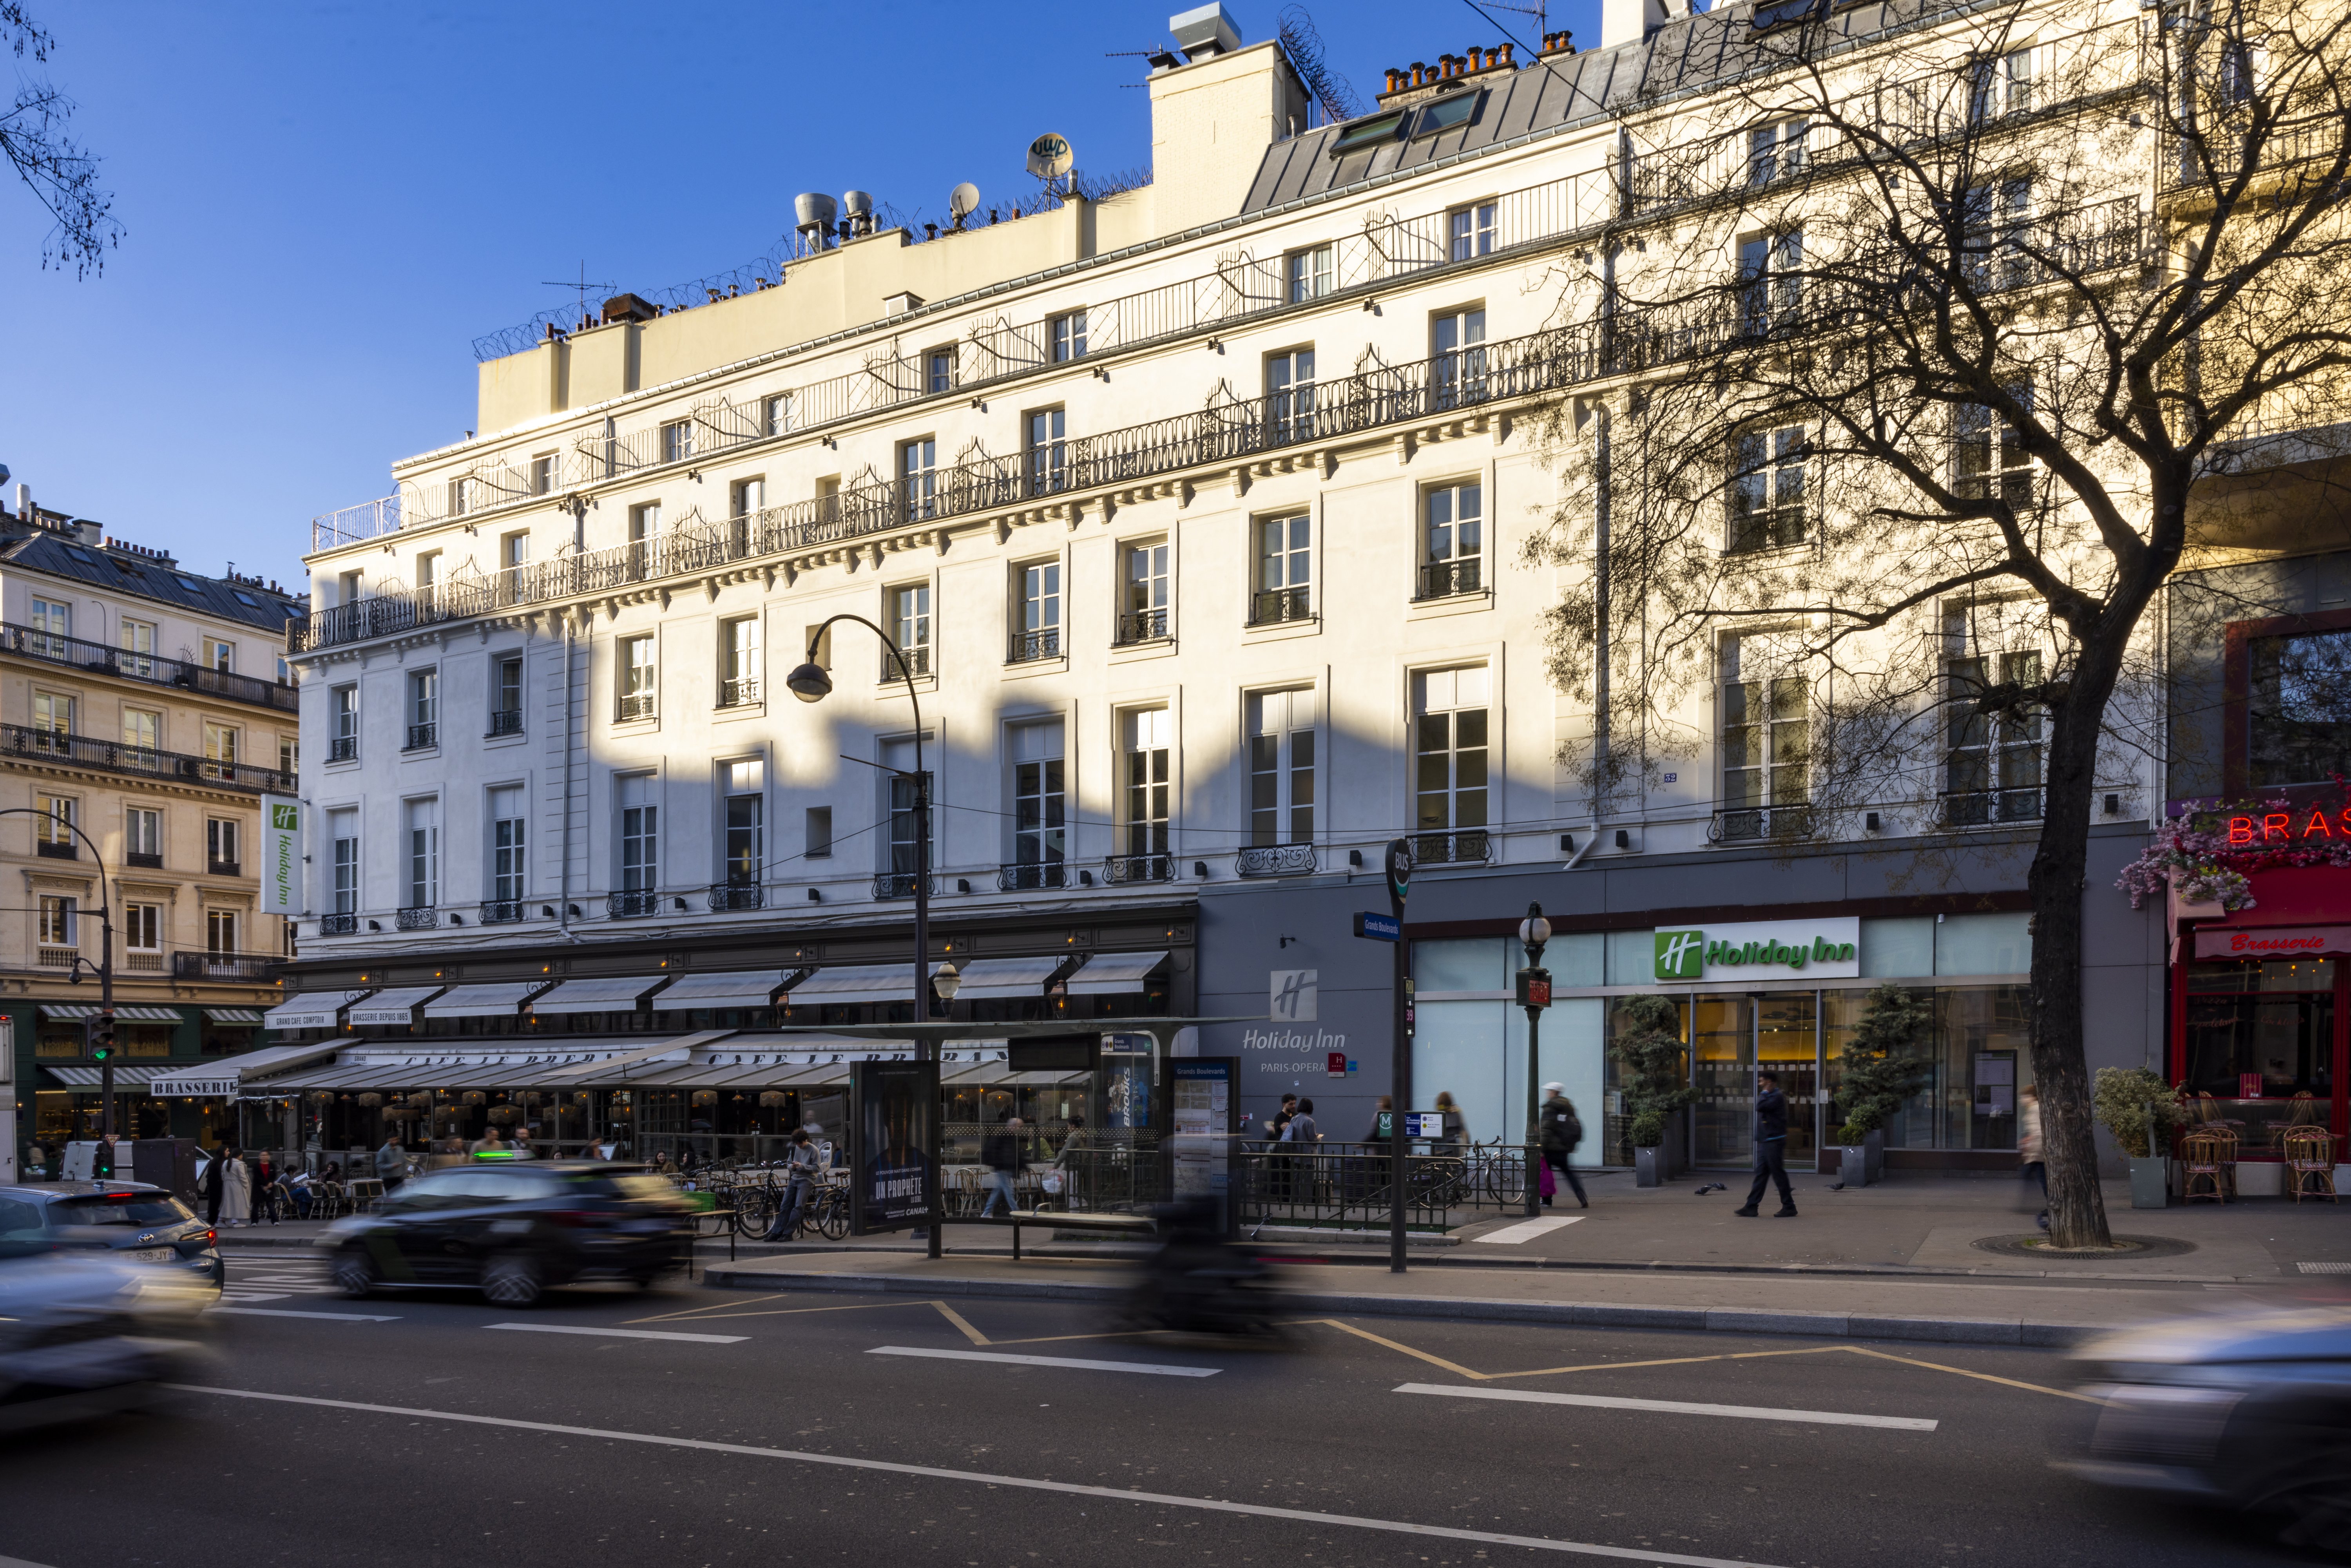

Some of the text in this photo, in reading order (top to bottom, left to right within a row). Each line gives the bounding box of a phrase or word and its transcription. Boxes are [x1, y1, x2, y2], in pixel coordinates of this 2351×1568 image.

[1395, 852, 1408, 871] BUS
[276, 834, 291, 905] Holiday Inn
[1365, 920, 1398, 934] Grands Boulevards
[2230, 934, 2325, 951] Brasserie
[1705, 936, 1854, 968] Holiday Inn
[1407, 981, 1413, 992] 20
[303, 1016, 324, 1024] COMPTOIR
[353, 1013, 377, 1021] BRASSERIE
[1407, 1009, 1413, 1021] 39
[1243, 1028, 1346, 1053] Holiday Inn
[1261, 1063, 1326, 1072] PARIS-OPERA
[154, 1081, 237, 1094] BRASSERIE
[876, 1175, 922, 1200] UN PROPHÈTE
[906, 1206, 928, 1216] CANAL+
